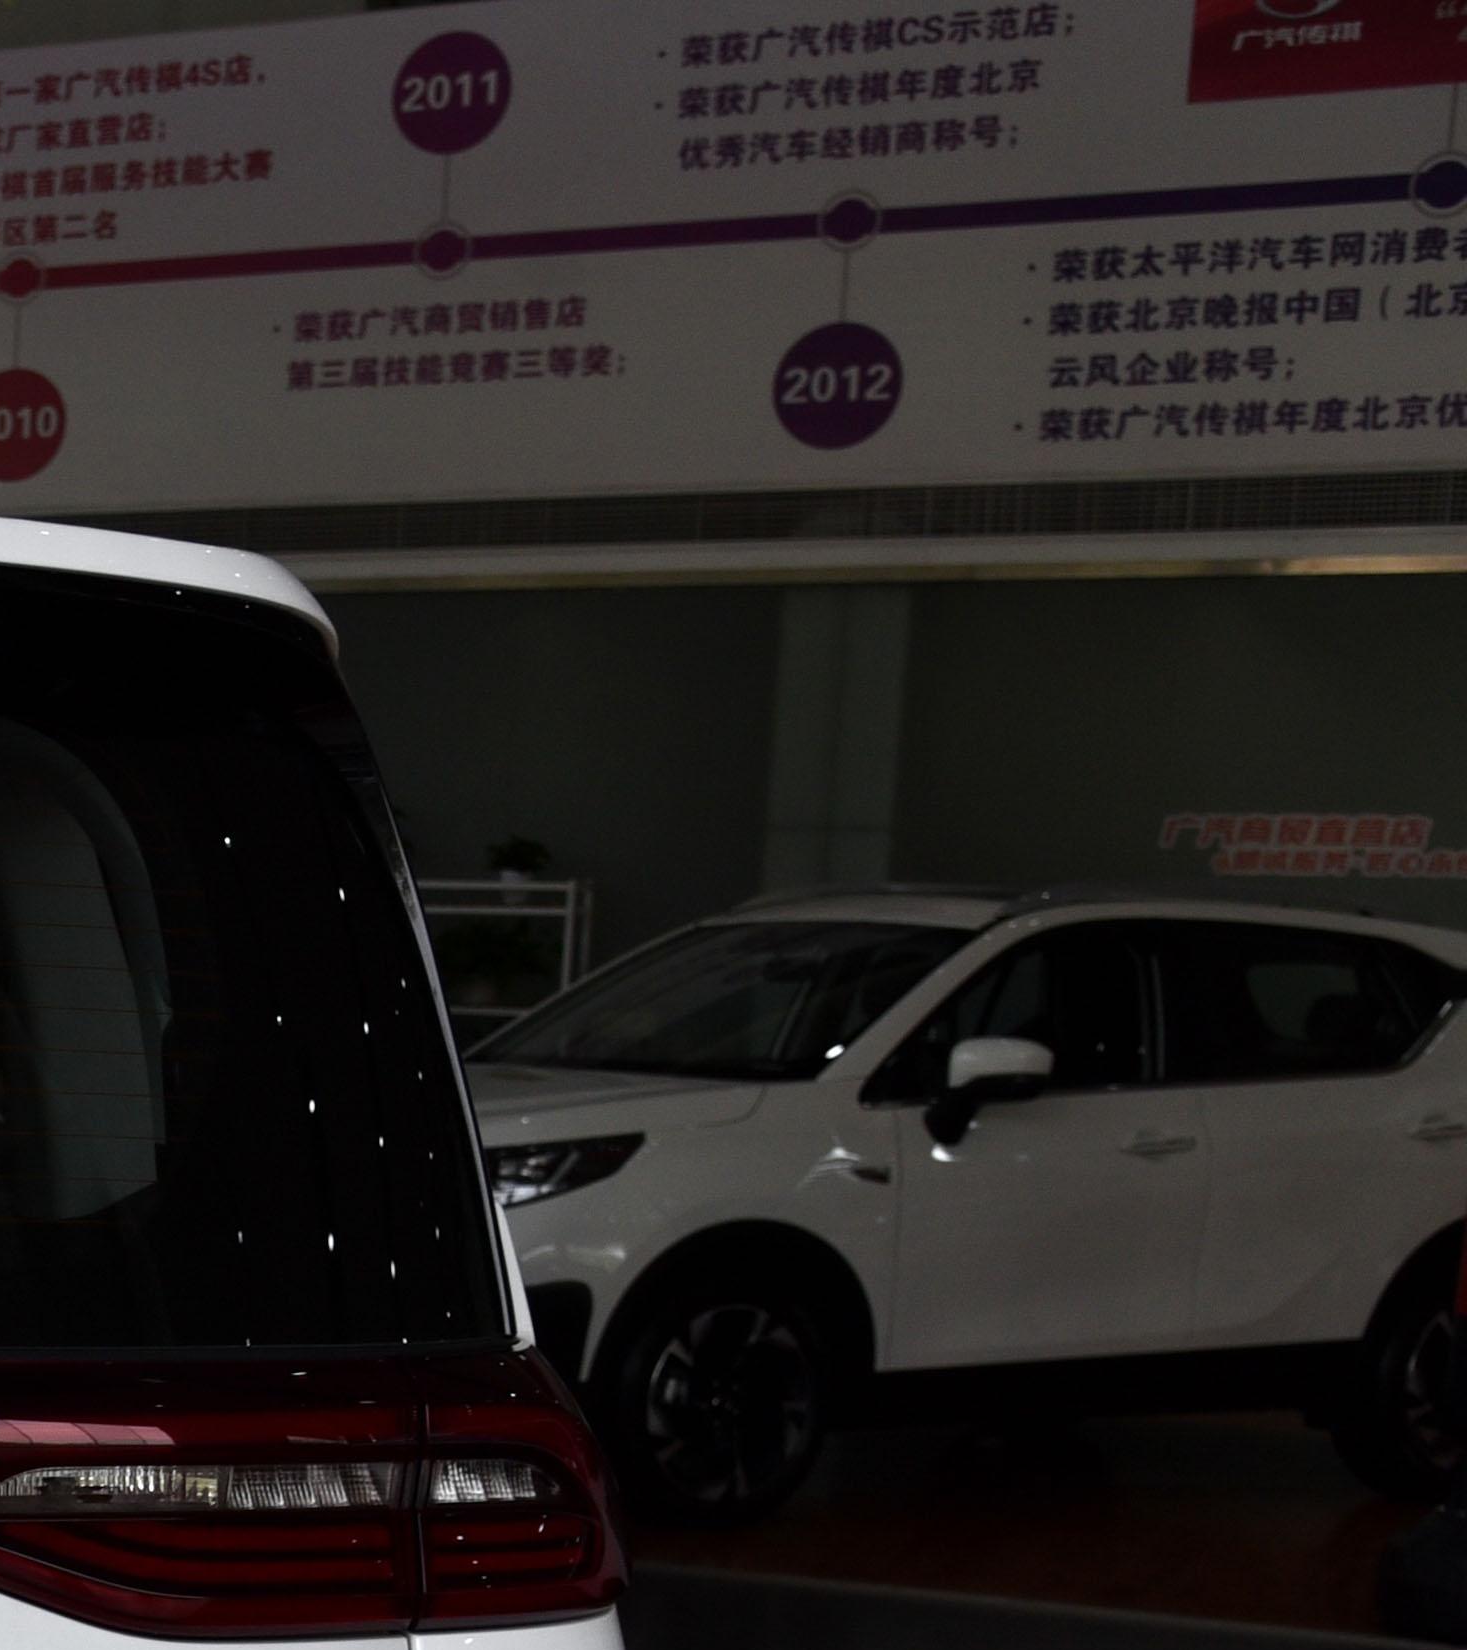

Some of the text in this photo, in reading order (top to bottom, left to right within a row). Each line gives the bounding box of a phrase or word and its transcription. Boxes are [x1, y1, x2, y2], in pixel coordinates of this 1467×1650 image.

[400, 68, 501, 112] 2011
[677, 58, 1043, 119] 荣获广汽传祺年度北京
[294, 294, 587, 342] 荣获广汽商贸销售店
[779, 362, 892, 407] 2012
